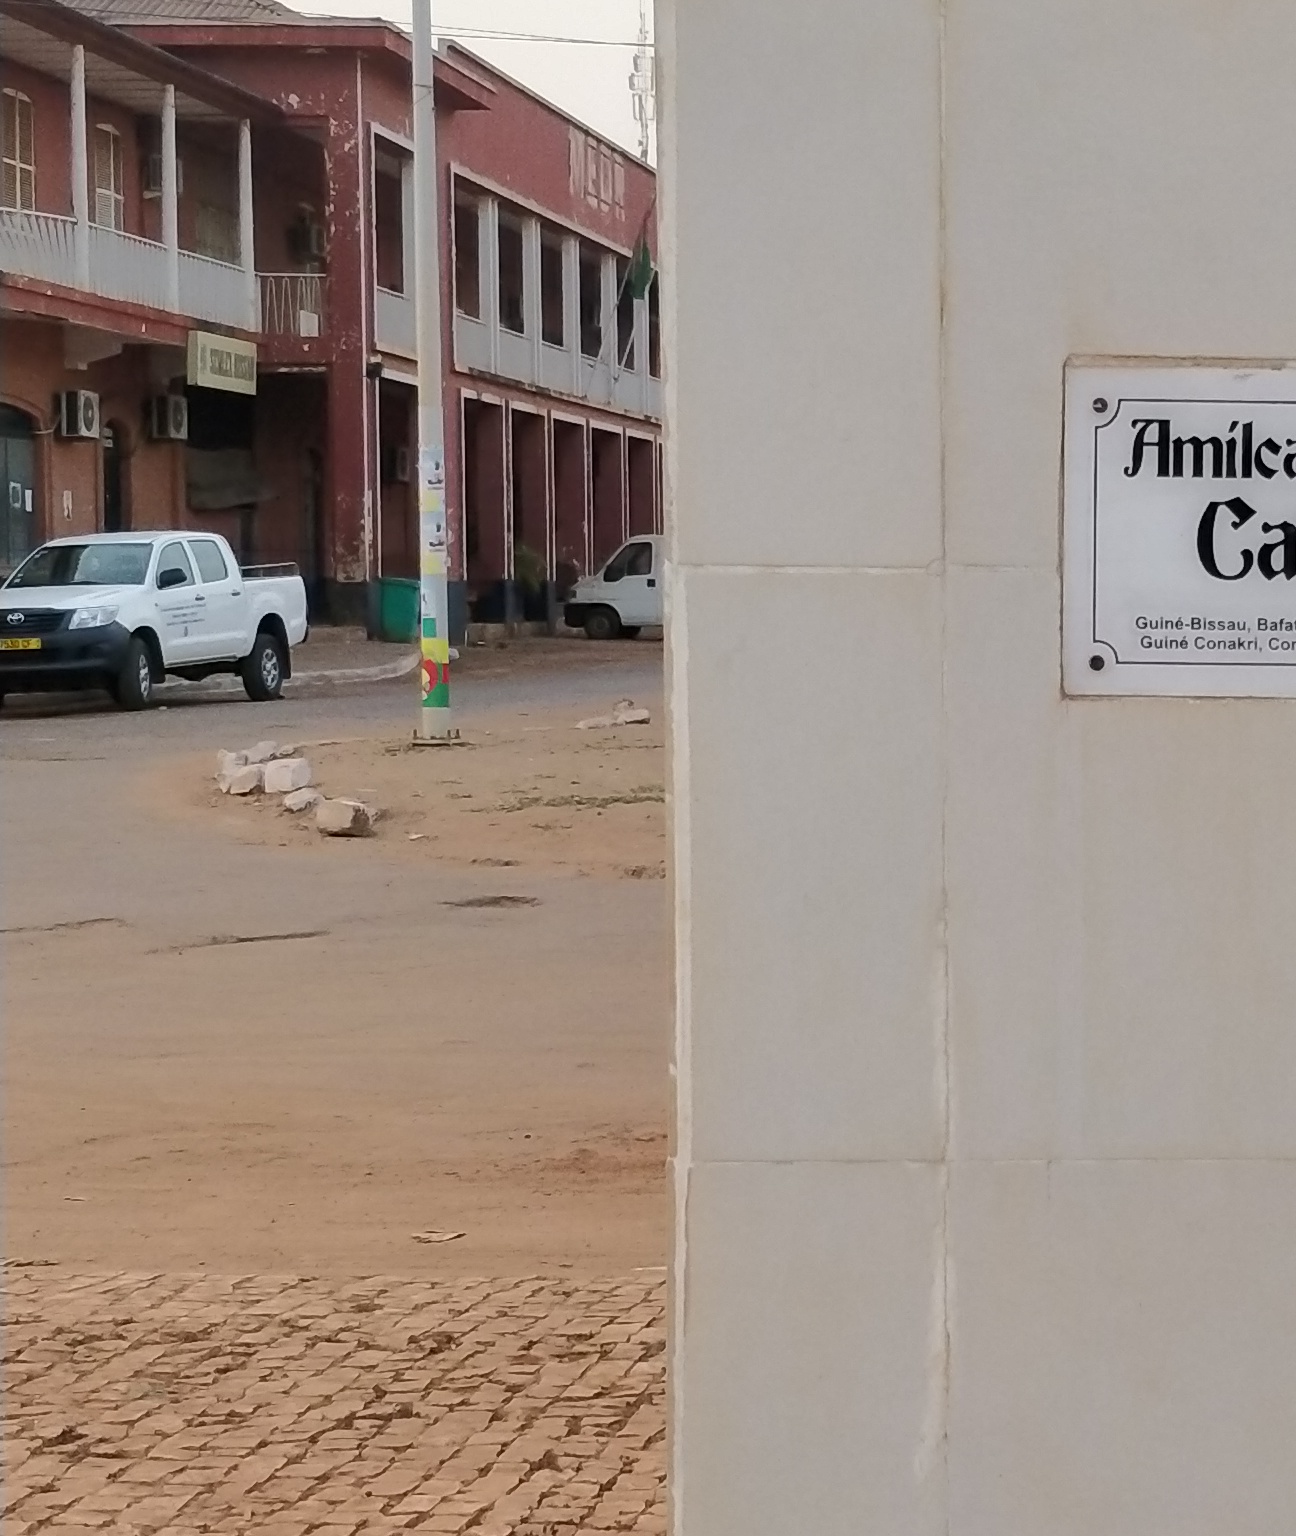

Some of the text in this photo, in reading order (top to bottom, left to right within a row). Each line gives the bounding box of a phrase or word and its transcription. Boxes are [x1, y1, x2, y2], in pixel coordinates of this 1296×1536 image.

[1135, 616, 1252, 634] Guiné-Bissau,
[1140, 635, 1189, 650] Guiné
[1193, 636, 1264, 653] Conakri,
